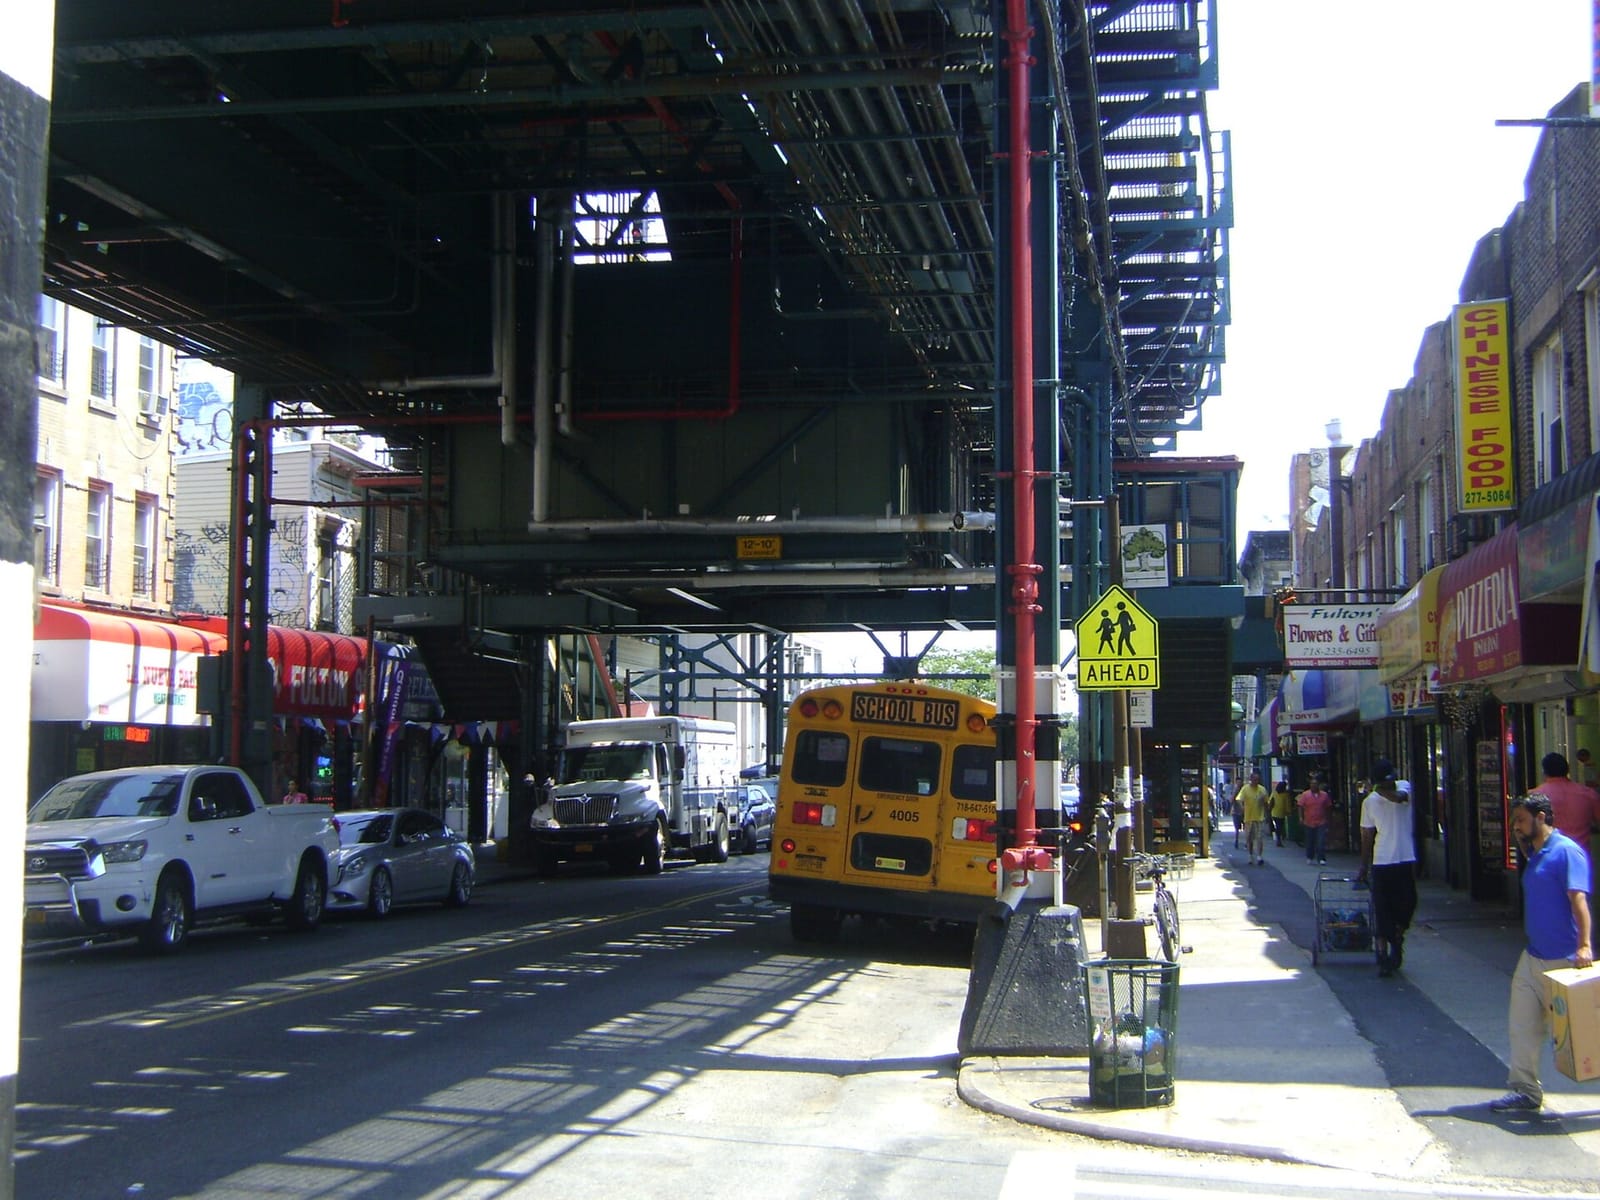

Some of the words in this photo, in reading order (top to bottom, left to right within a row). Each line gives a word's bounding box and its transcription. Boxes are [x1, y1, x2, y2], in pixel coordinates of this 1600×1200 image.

[1464, 308, 1500, 415] CHINESE
[1467, 427, 1505, 489] FOOD
[1465, 489, 1511, 505] 277-5064
[1456, 563, 1518, 642] PIZZERIA
[1311, 607, 1383, 619] Fulton'
[1288, 624, 1333, 643] Flowers
[1339, 624, 1350, 643] &
[1303, 646, 1371, 656] 718-235-6495
[1086, 663, 1150, 681] AHEAD
[291, 665, 349, 707] FULTON
[856, 696, 916, 722] SCHOOL
[923, 702, 954, 726] BUS
[1295, 712, 1320, 720] DAYS
[1300, 735, 1325, 744] ATM
[889, 810, 920, 823] 4005
